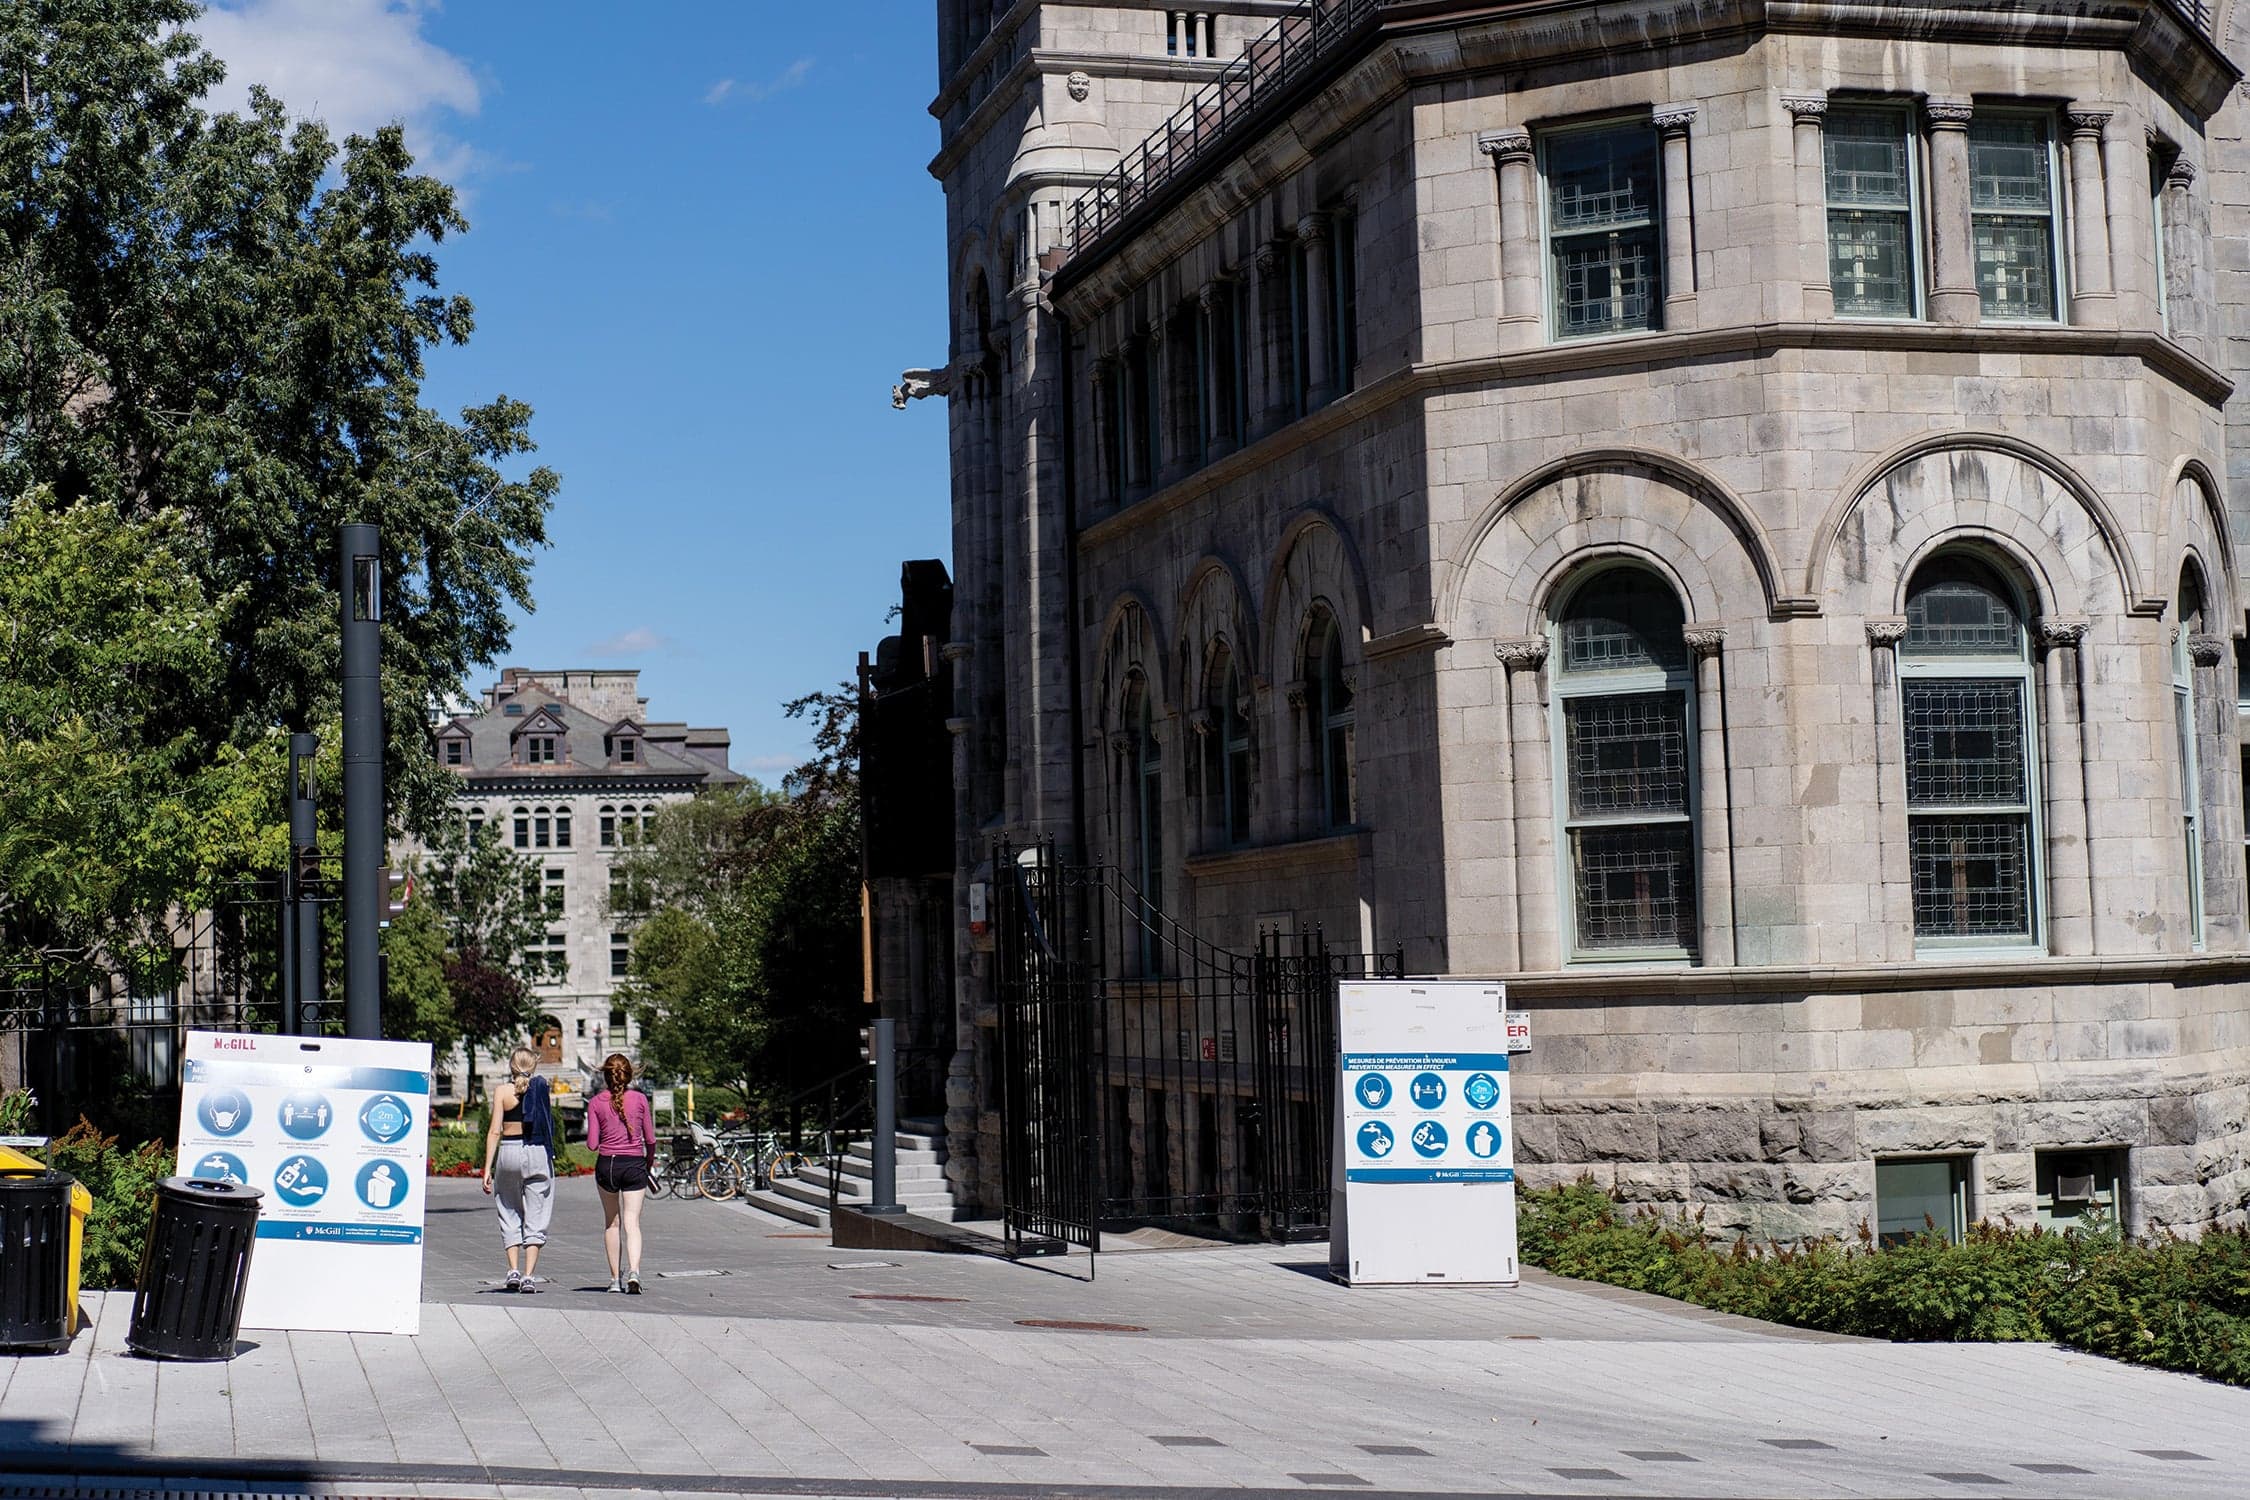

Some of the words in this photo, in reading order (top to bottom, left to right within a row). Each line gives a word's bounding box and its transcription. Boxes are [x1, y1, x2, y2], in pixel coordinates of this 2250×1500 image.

[1507, 1026, 1528, 1037] ER
[378, 1111, 393, 1120] 2m
[315, 1227, 341, 1235] McGill
